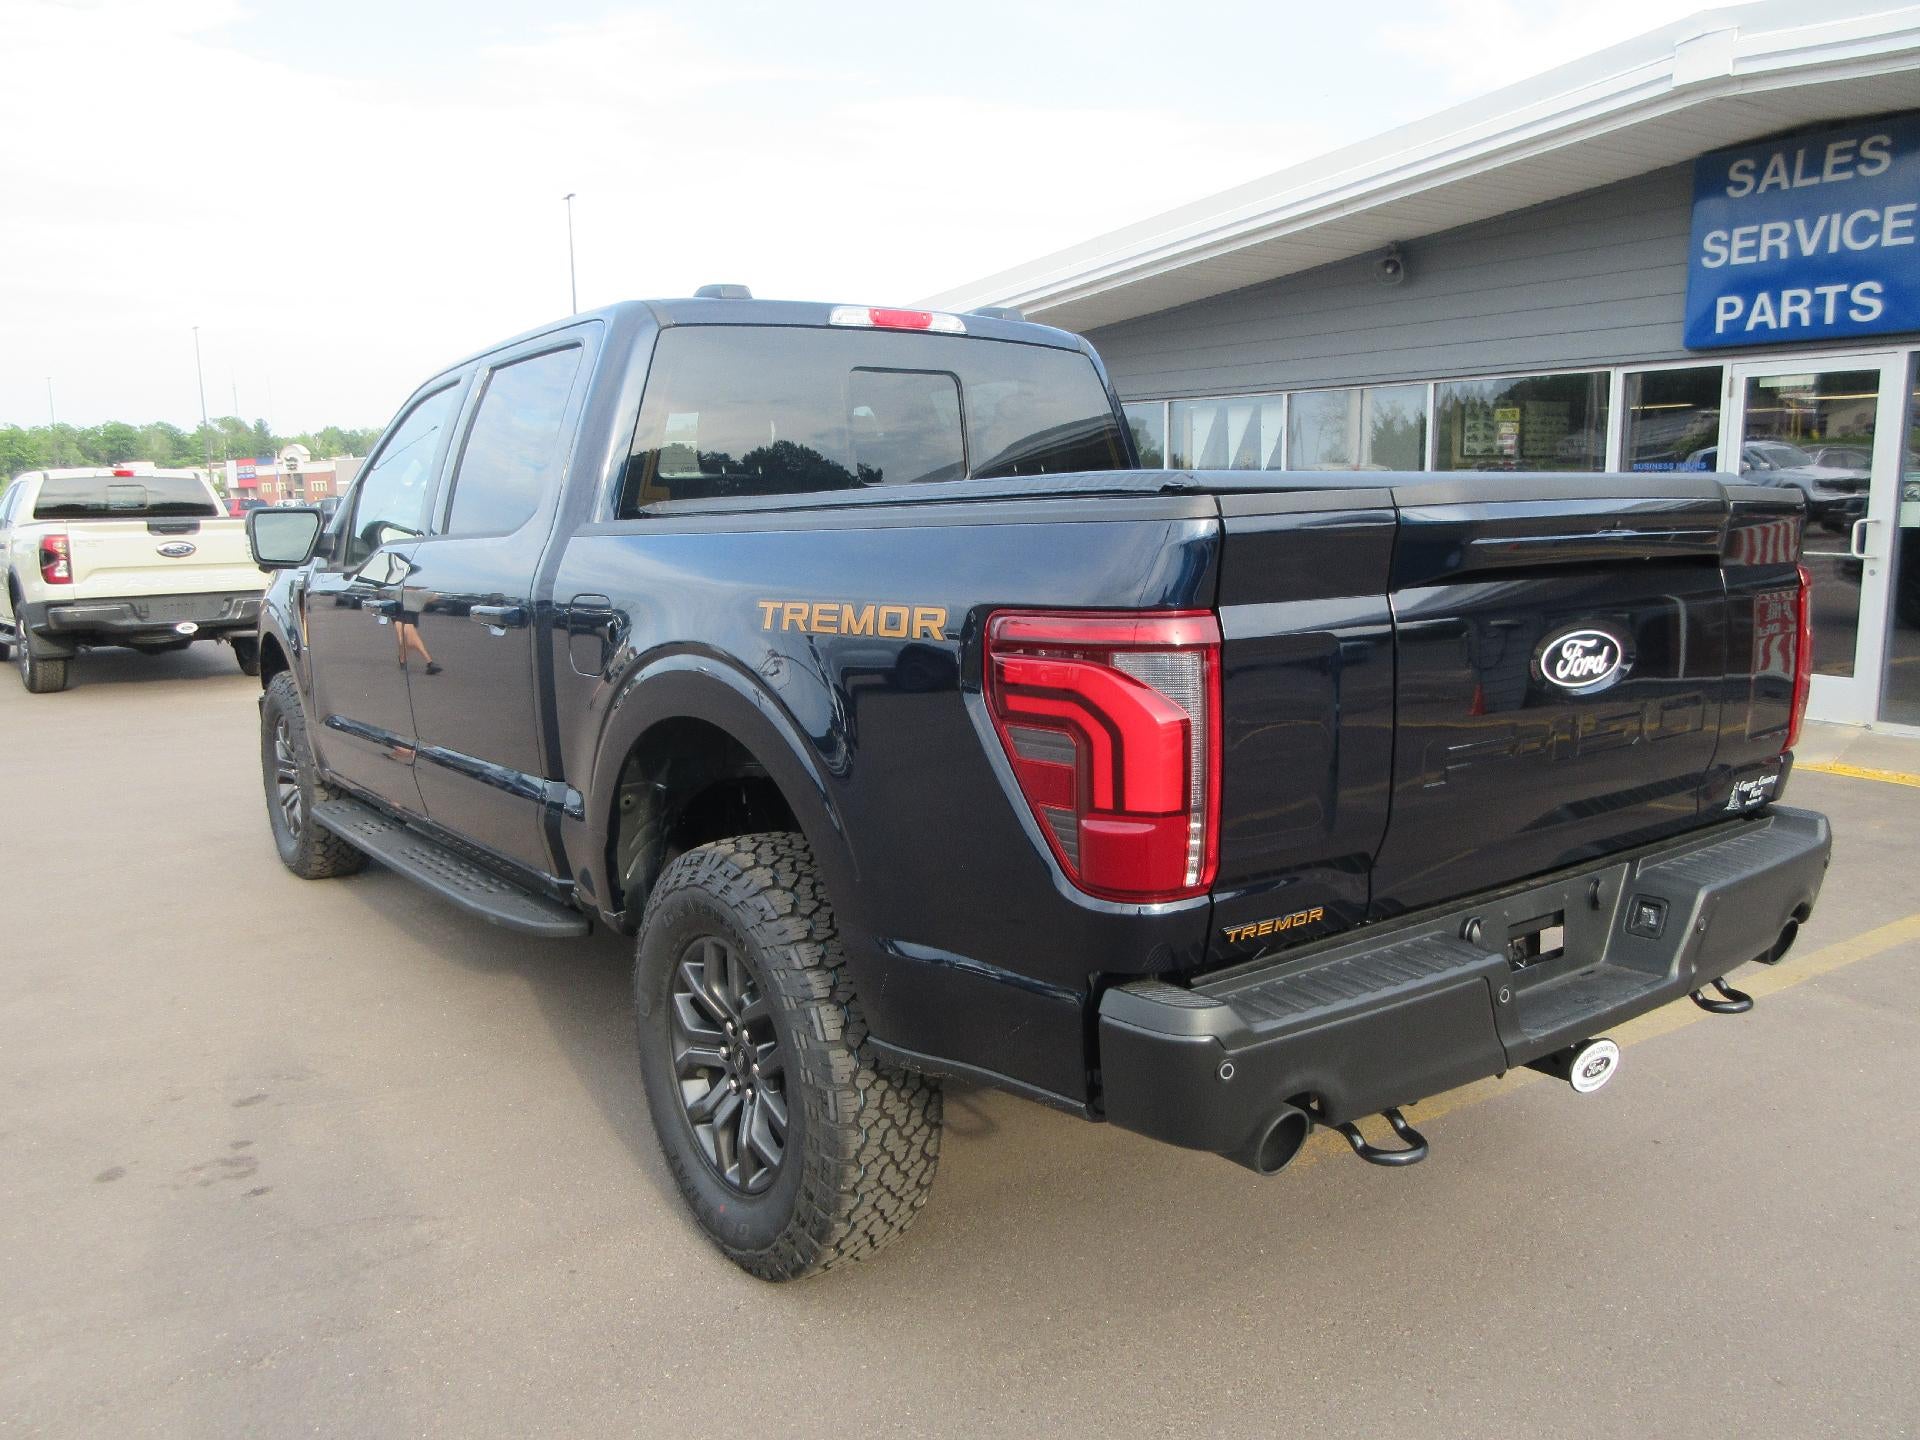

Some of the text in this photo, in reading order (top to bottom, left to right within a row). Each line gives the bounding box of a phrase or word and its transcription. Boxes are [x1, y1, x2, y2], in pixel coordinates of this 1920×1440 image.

[1726, 134, 1893, 199] SALES
[1701, 203, 1918, 269] SERVICE
[1714, 280, 1884, 334] PARTS
[1633, 463, 1674, 471] BUSINESS
[758, 601, 947, 641] TREMOR
[1556, 638, 1610, 679] Ford
[1222, 906, 1325, 943] TREMOR
